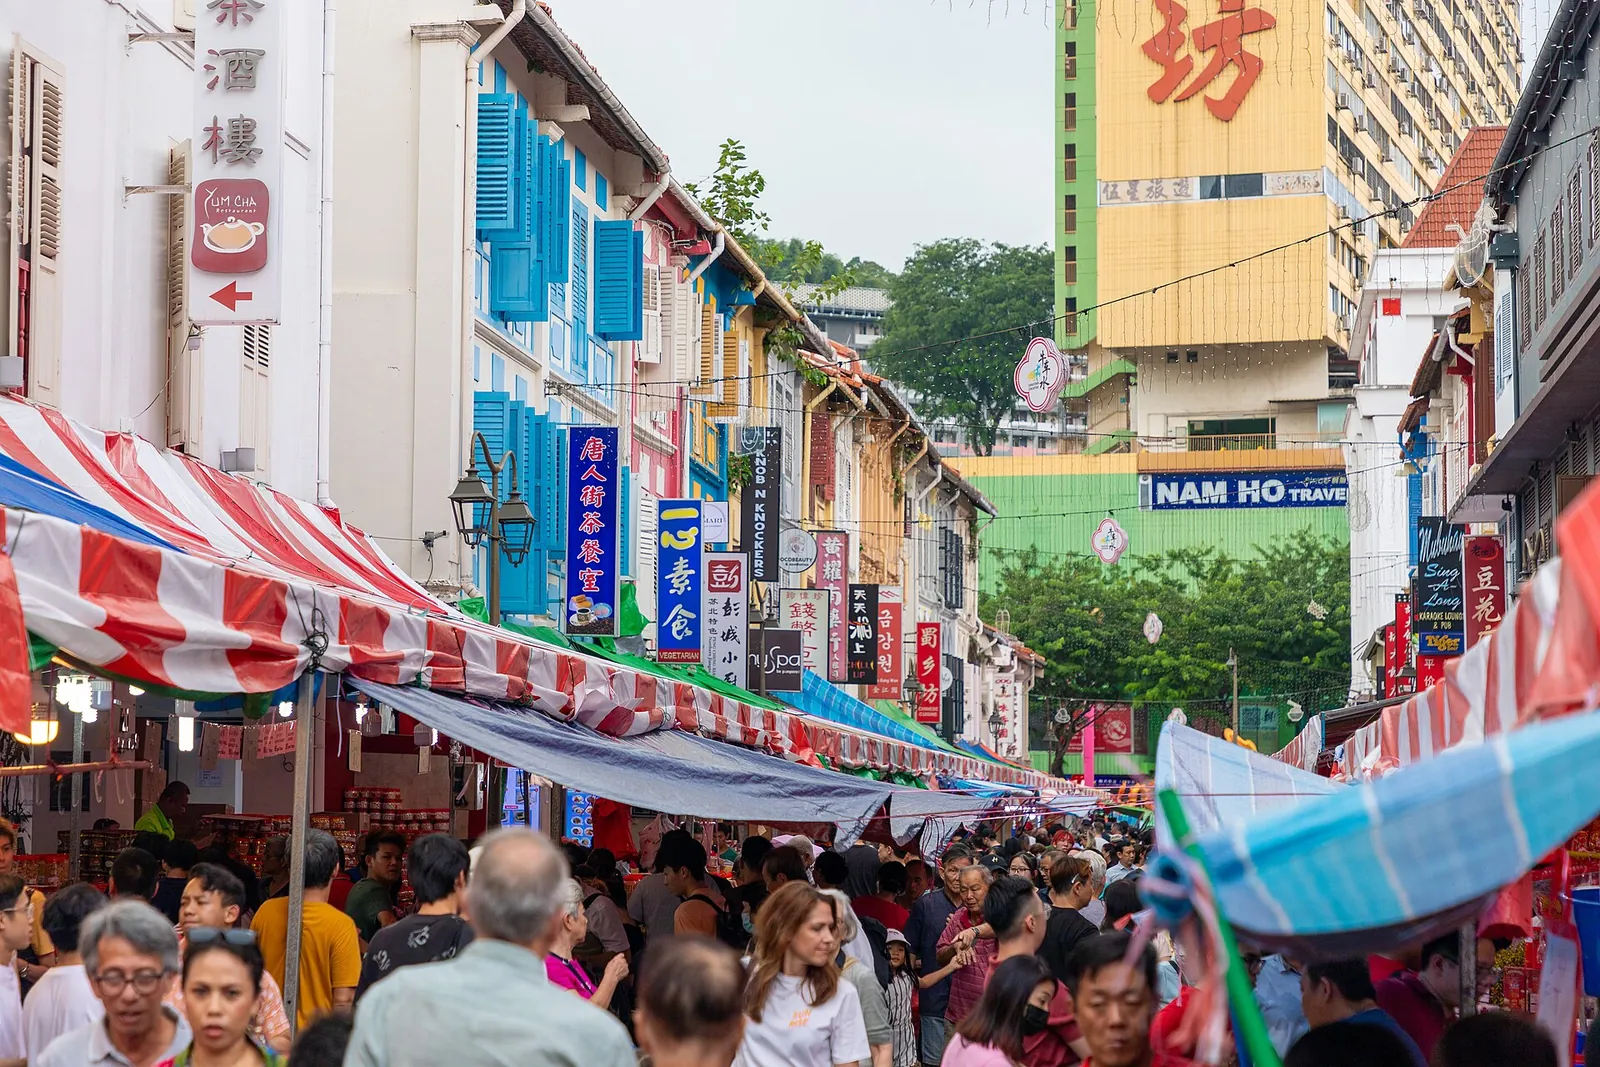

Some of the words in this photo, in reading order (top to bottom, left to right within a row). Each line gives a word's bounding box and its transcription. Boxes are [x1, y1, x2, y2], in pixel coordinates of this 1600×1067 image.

[1141, 0, 1276, 123] 坊
[204, 187, 230, 220] YUM
[234, 194, 257, 208] CHA
[754, 489, 766, 499] N
[1157, 481, 1227, 504] NAM
[1239, 479, 1285, 504] HO
[1288, 487, 1348, 502] TRAVE
[577, 436, 607, 593] 唐人街茶餐室
[753, 503, 767, 578] KNOCKERS
[660, 507, 700, 642] 一心素食
[1424, 564, 1461, 581] Sing
[1423, 595, 1462, 611] Long
[1419, 611, 1444, 621] KARAOKE
[1444, 612, 1463, 621] LOUNG
[1433, 621, 1438, 630] &
[1440, 621, 1452, 630] PUB
[877, 609, 895, 673] 금강원
[1425, 635, 1461, 651] Tiger
[659, 651, 700, 661] VEGETARIAN
[853, 671, 866, 679] UP
